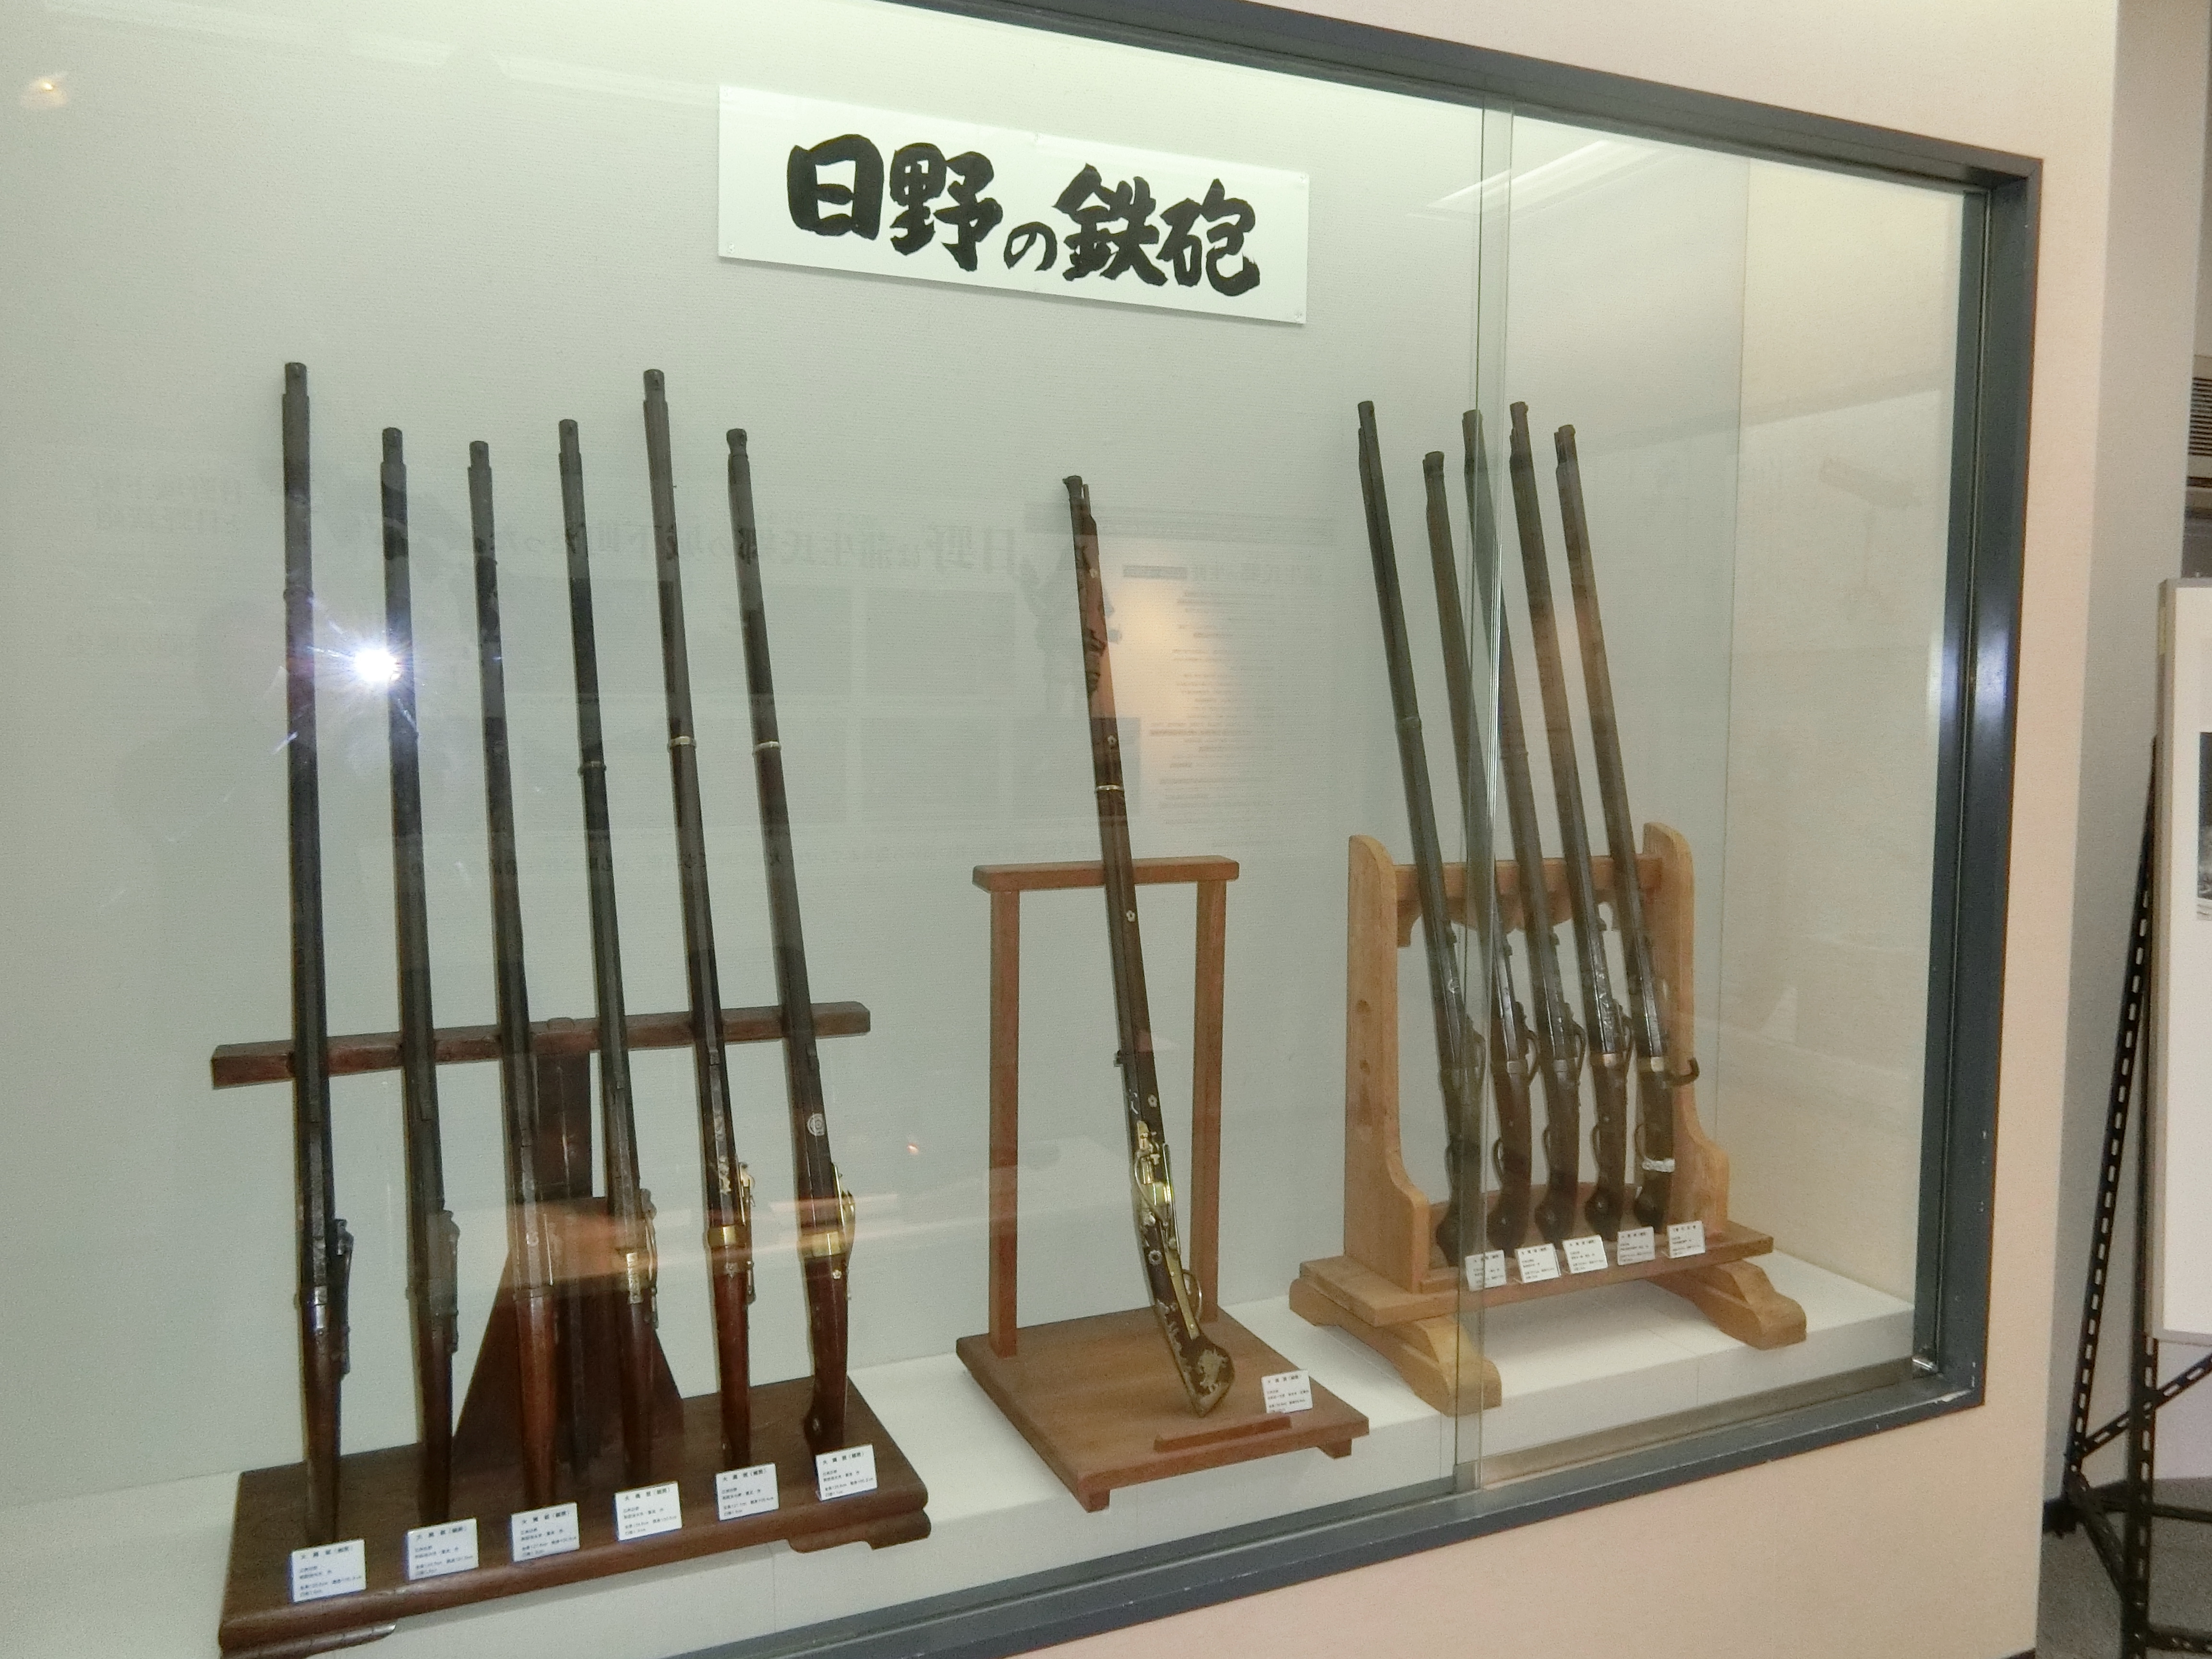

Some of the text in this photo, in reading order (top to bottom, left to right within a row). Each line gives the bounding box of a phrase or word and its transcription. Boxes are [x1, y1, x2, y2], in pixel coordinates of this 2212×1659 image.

[787, 133, 1260, 296] 日野の鉄砲
